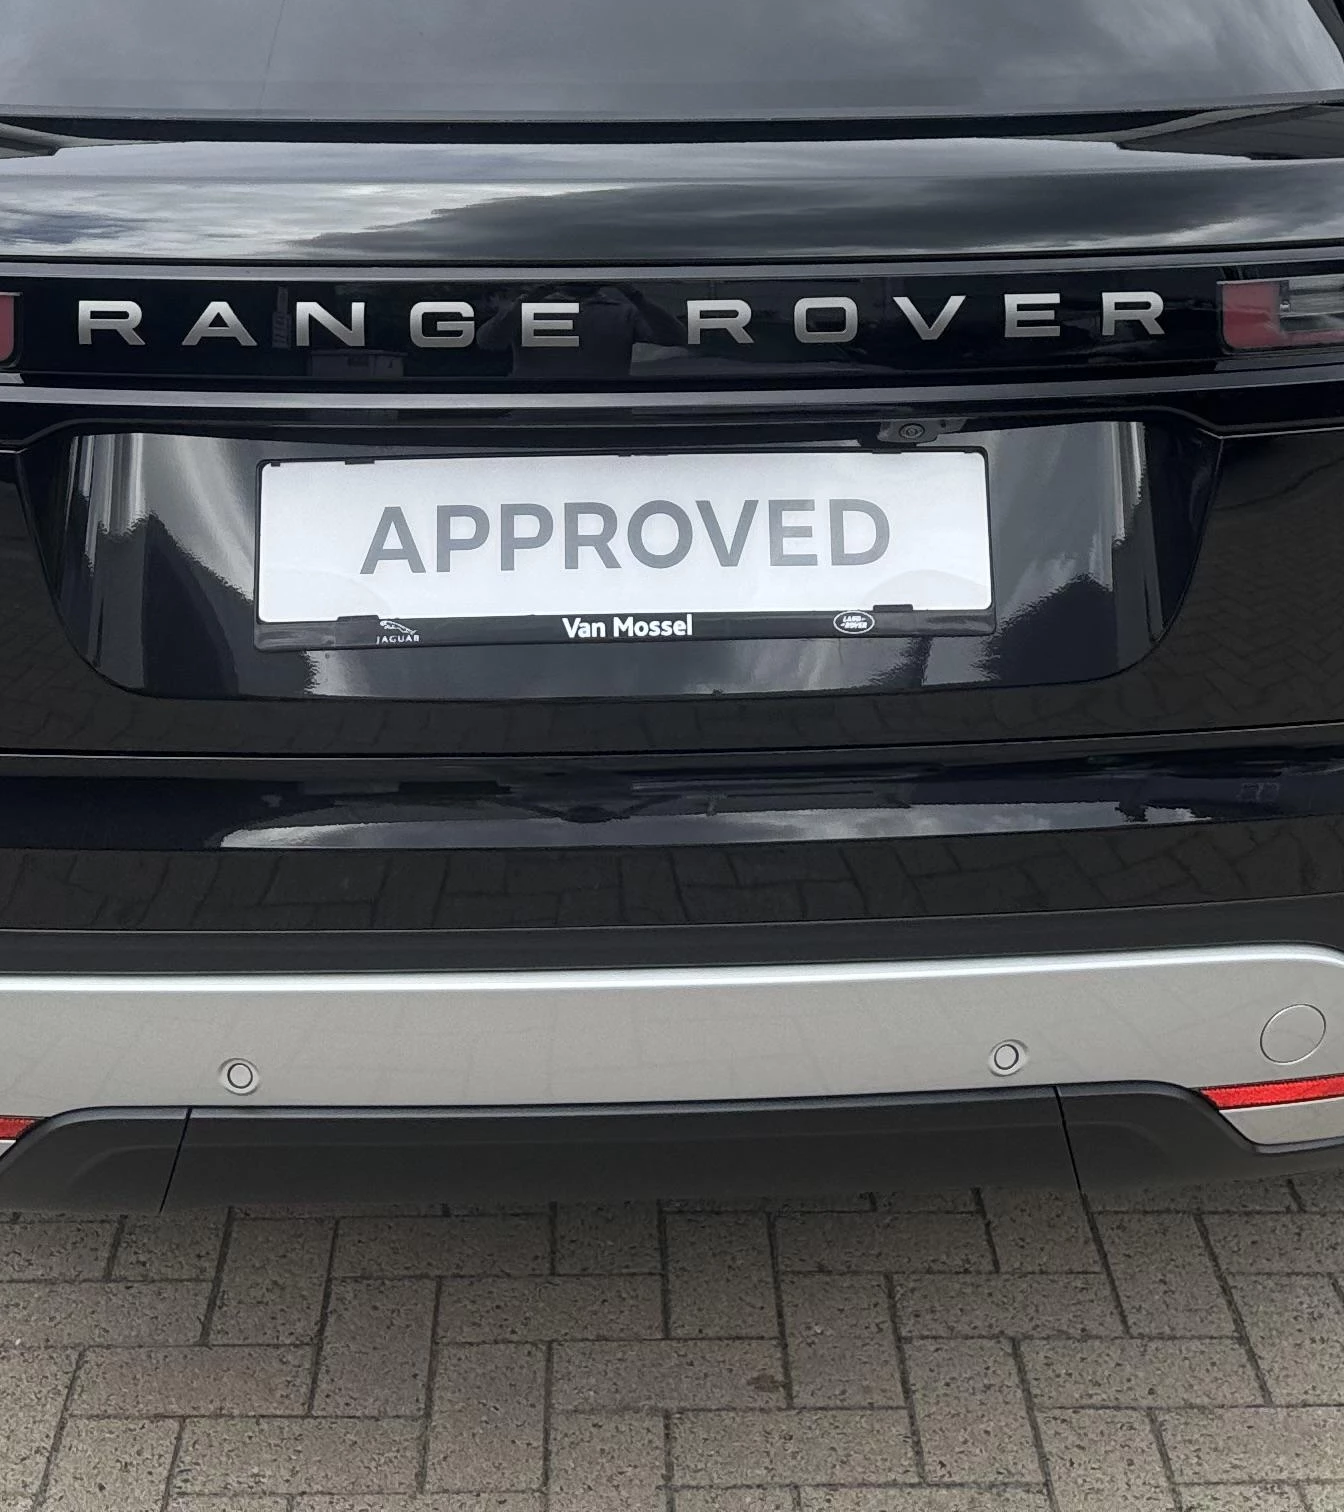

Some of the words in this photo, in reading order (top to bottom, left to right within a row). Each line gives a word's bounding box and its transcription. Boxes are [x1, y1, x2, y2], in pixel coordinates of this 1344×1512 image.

[78, 299, 582, 349] RANGE
[686, 290, 1167, 345] ROVER
[360, 497, 891, 575] APPROVED
[376, 634, 419, 645] JAGUAR
[562, 617, 606, 638] Van
[613, 613, 693, 637] Mossel
